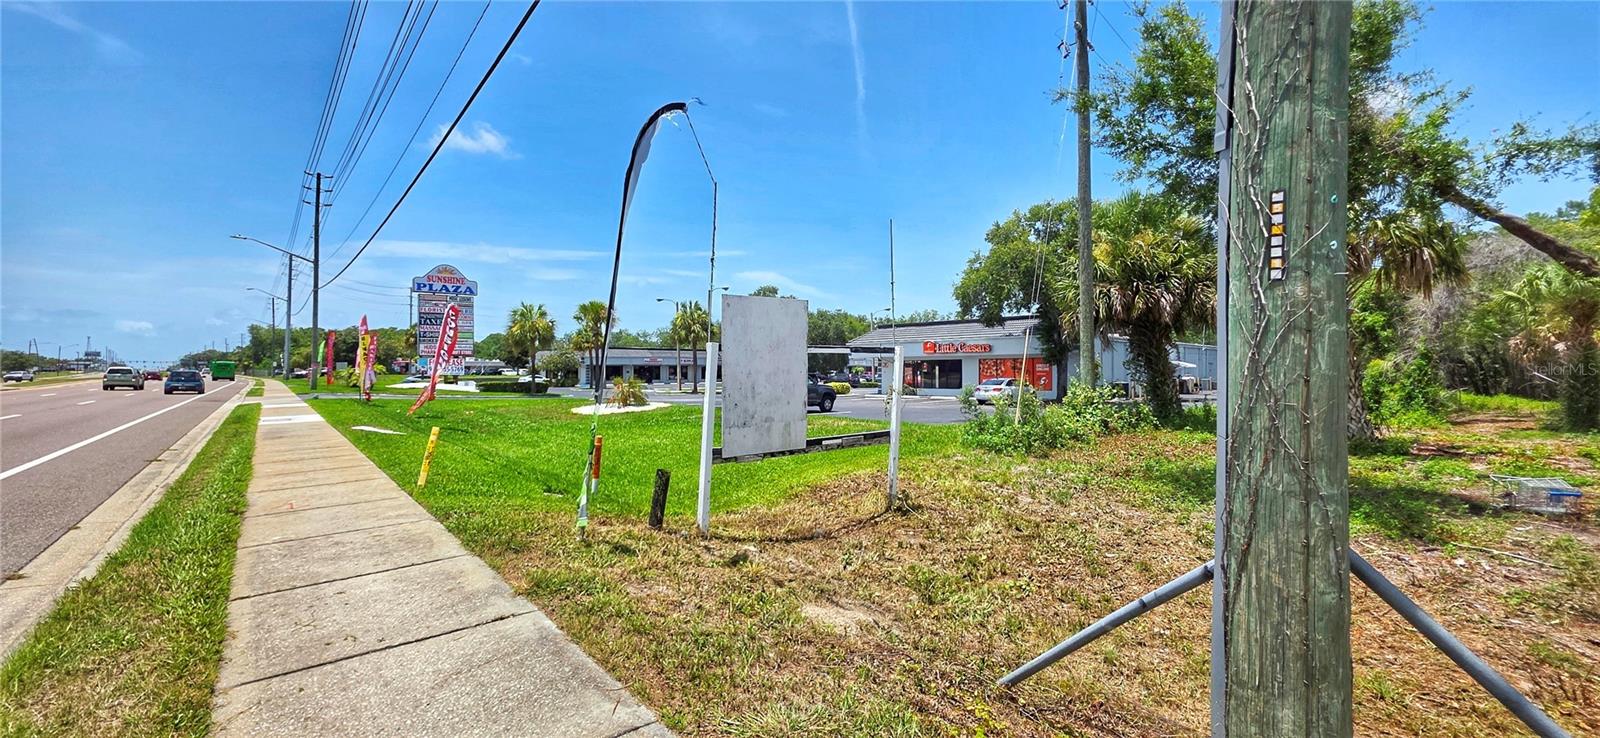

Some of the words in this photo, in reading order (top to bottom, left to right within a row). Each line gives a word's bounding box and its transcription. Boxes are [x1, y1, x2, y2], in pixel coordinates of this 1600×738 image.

[426, 275, 466, 285] SUNSHINE
[415, 282, 476, 295] PLAZA
[936, 343, 957, 353] Little
[958, 342, 991, 353] Caesars
